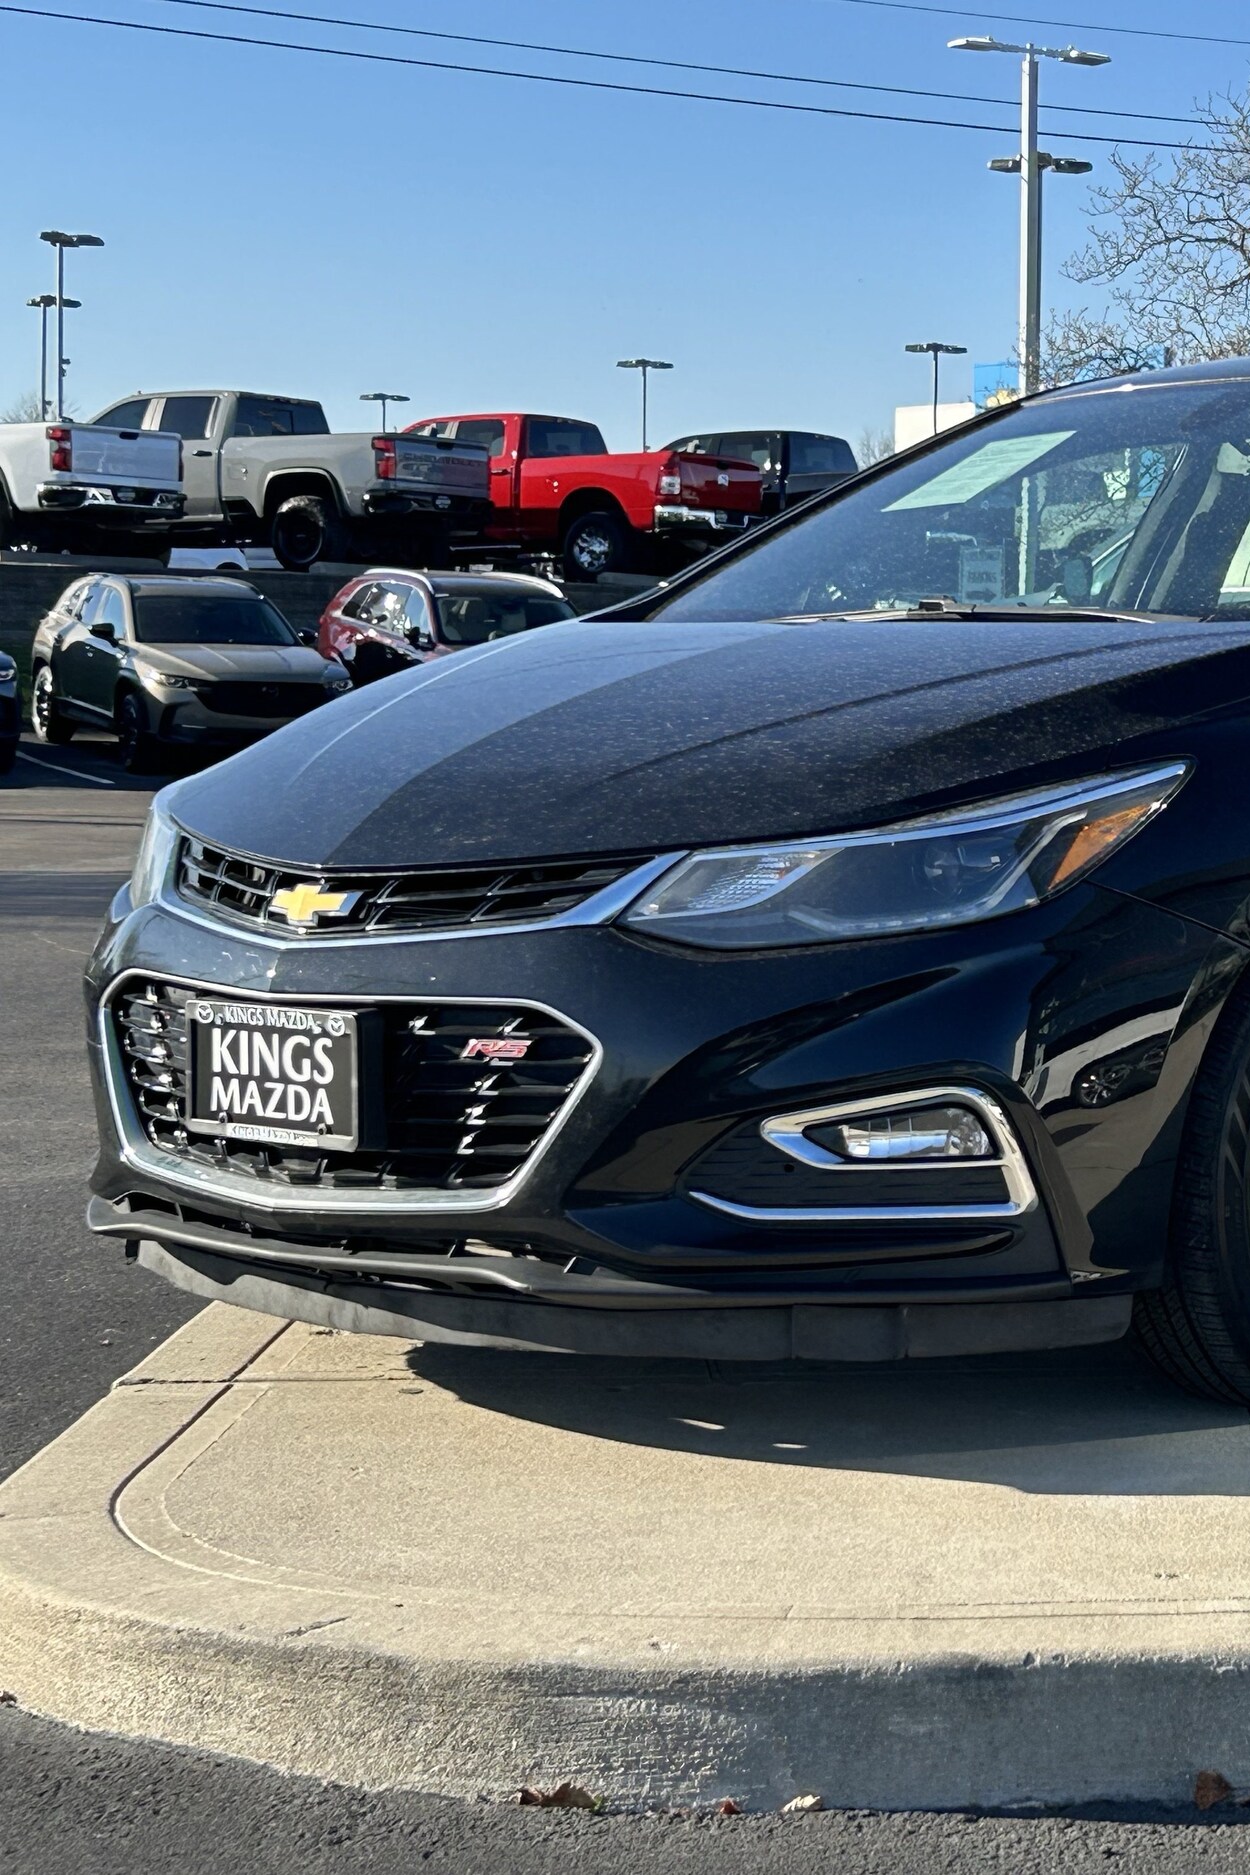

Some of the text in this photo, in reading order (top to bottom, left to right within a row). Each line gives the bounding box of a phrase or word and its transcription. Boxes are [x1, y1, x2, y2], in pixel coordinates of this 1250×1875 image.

[223, 1005, 316, 1032] KINGS MAZDA
[211, 1027, 335, 1085] KINGS
[209, 1075, 335, 1126] MAZDA
